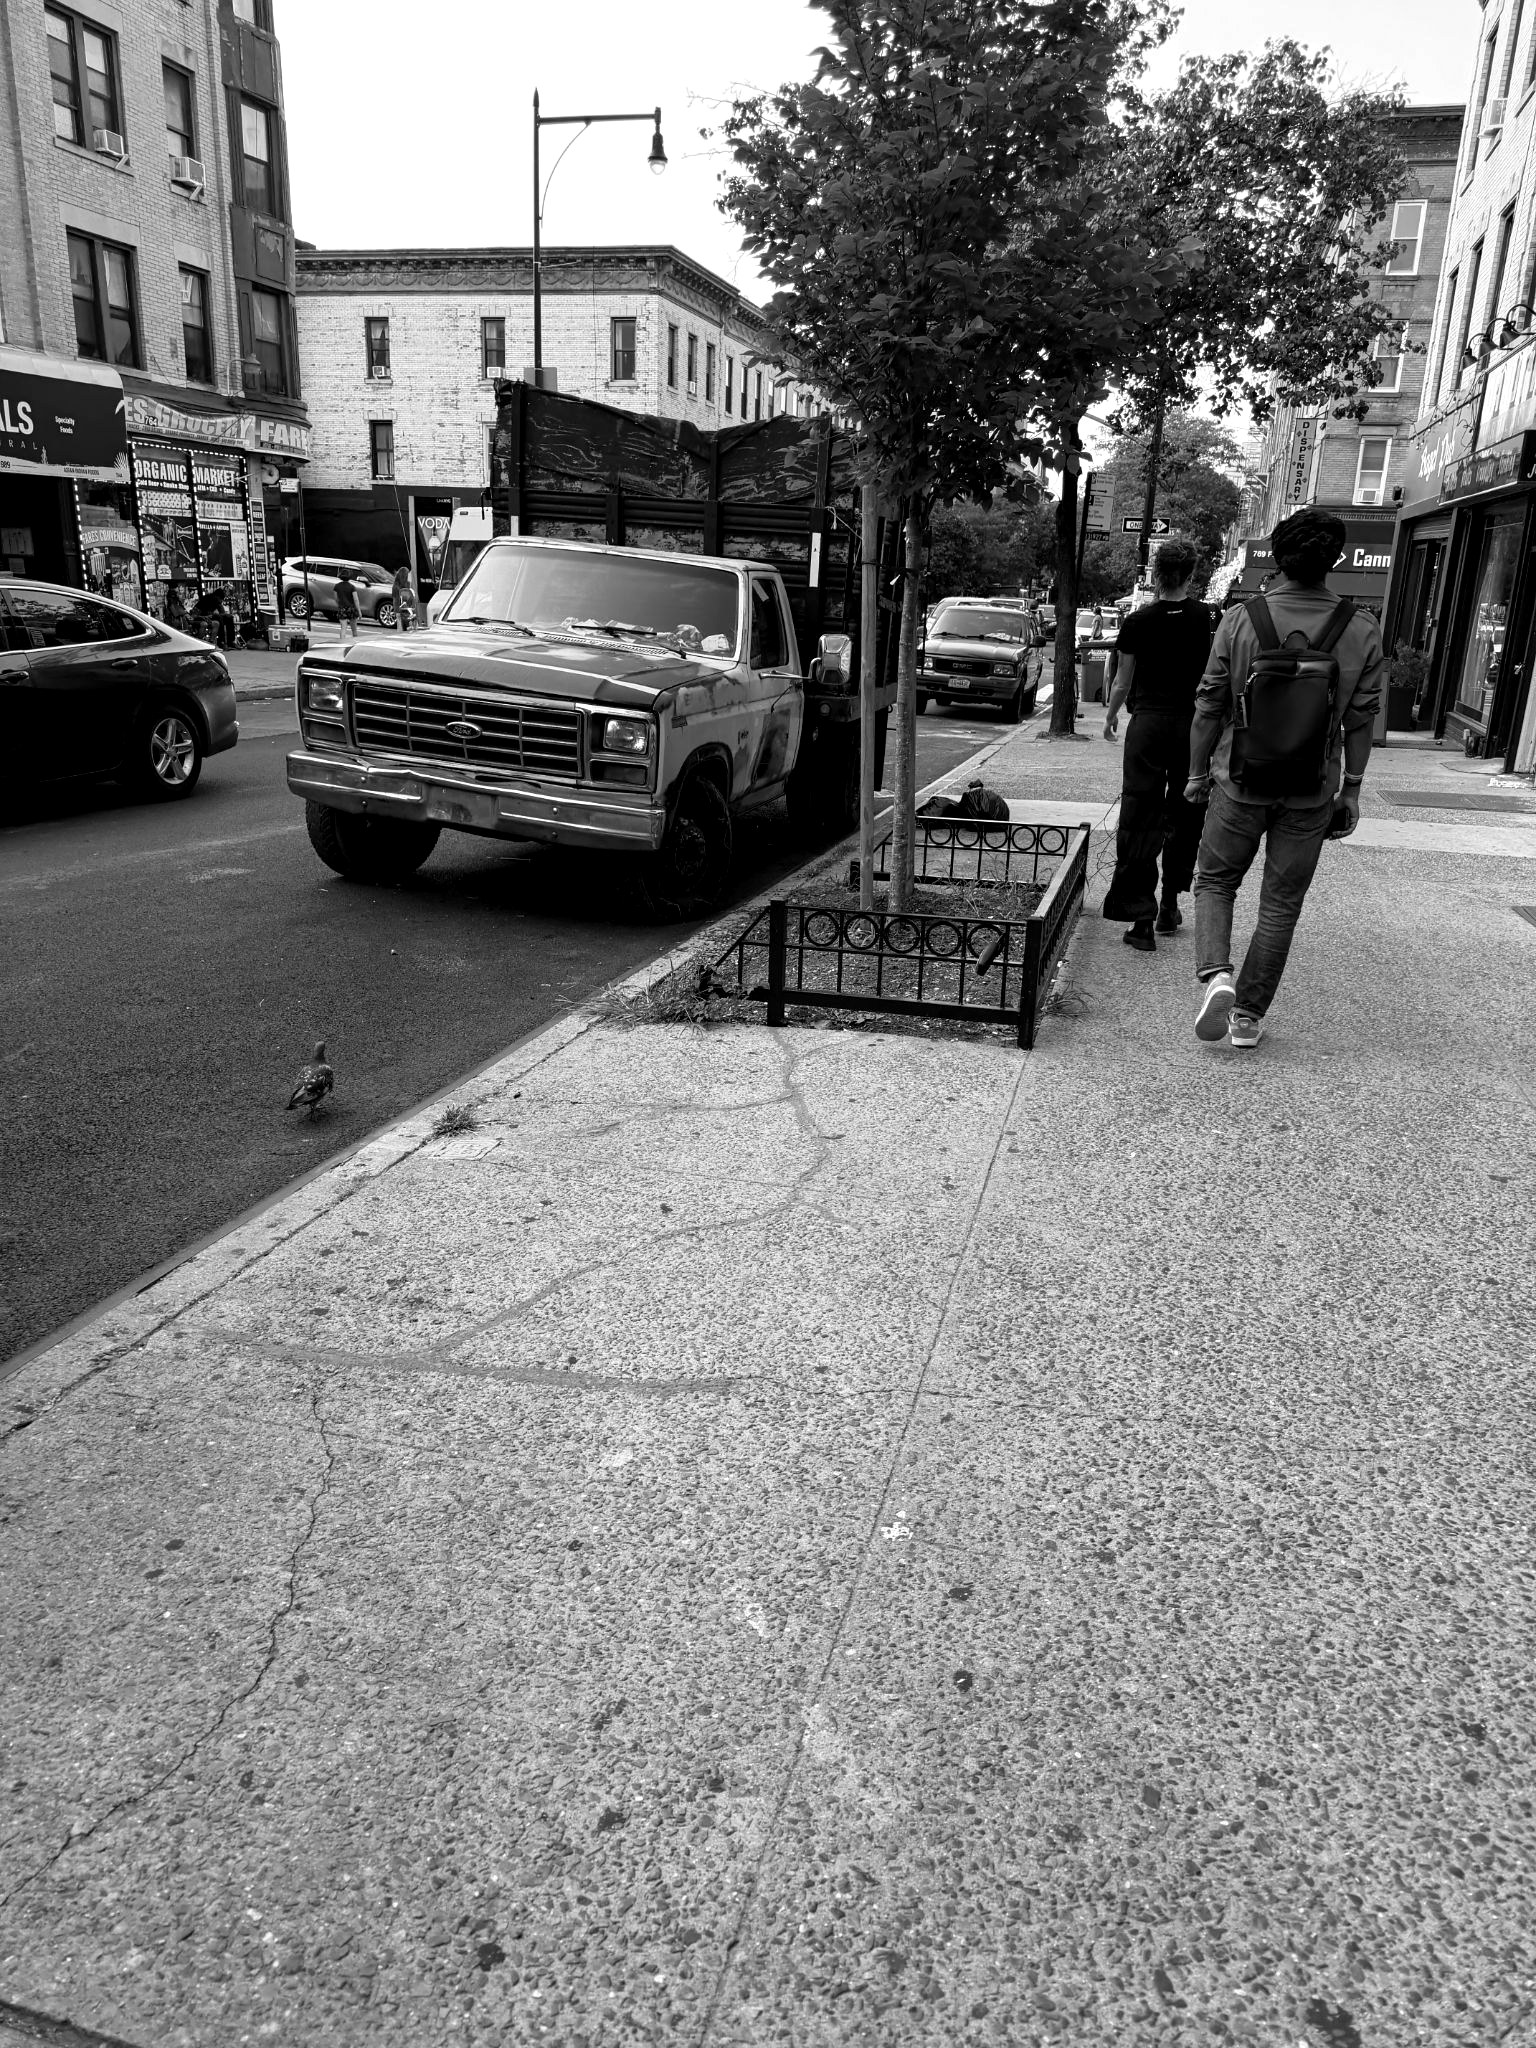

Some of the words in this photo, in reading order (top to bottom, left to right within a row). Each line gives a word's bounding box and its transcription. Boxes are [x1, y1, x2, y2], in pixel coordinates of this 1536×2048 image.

[0, 399, 34, 435] LS
[55, 415, 75, 426] Specialty
[145, 415, 158, 426] 764
[0, 440, 38, 450] RAL
[1293, 421, 1310, 501] DISPENSARY
[135, 459, 188, 483] ORGANIC
[192, 467, 236, 487] MARKET
[1129, 521, 1143, 530] ONE
[1352, 548, 1391, 568] Cann
[952, 662, 973, 670] GMC
